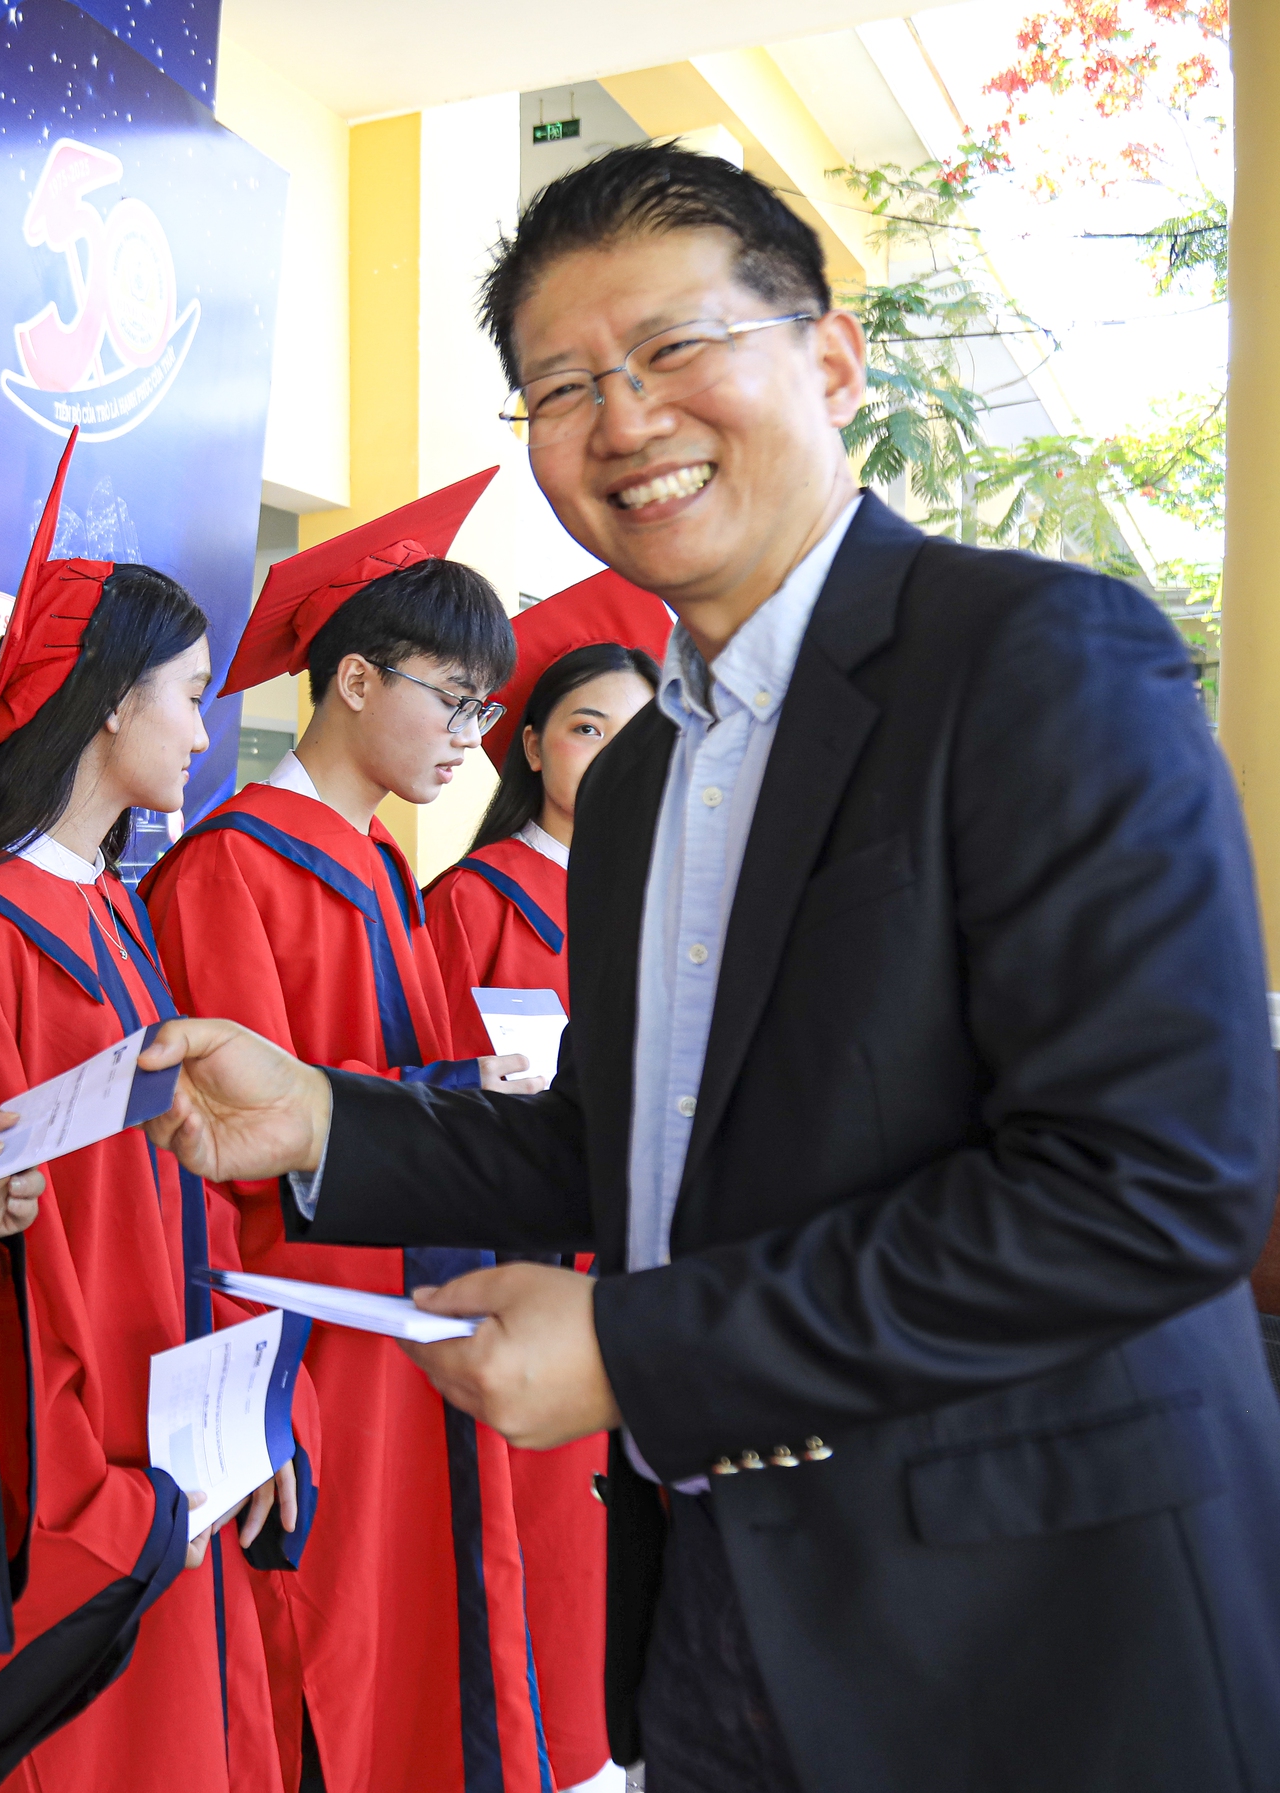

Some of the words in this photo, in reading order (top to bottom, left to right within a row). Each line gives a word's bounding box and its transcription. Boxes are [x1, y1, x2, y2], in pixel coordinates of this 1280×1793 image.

[54, 400, 72, 422] TIẾN
[82, 401, 96, 424] CỦA
[96, 400, 111, 422] TRÒ
[111, 397, 120, 419] LÀ
